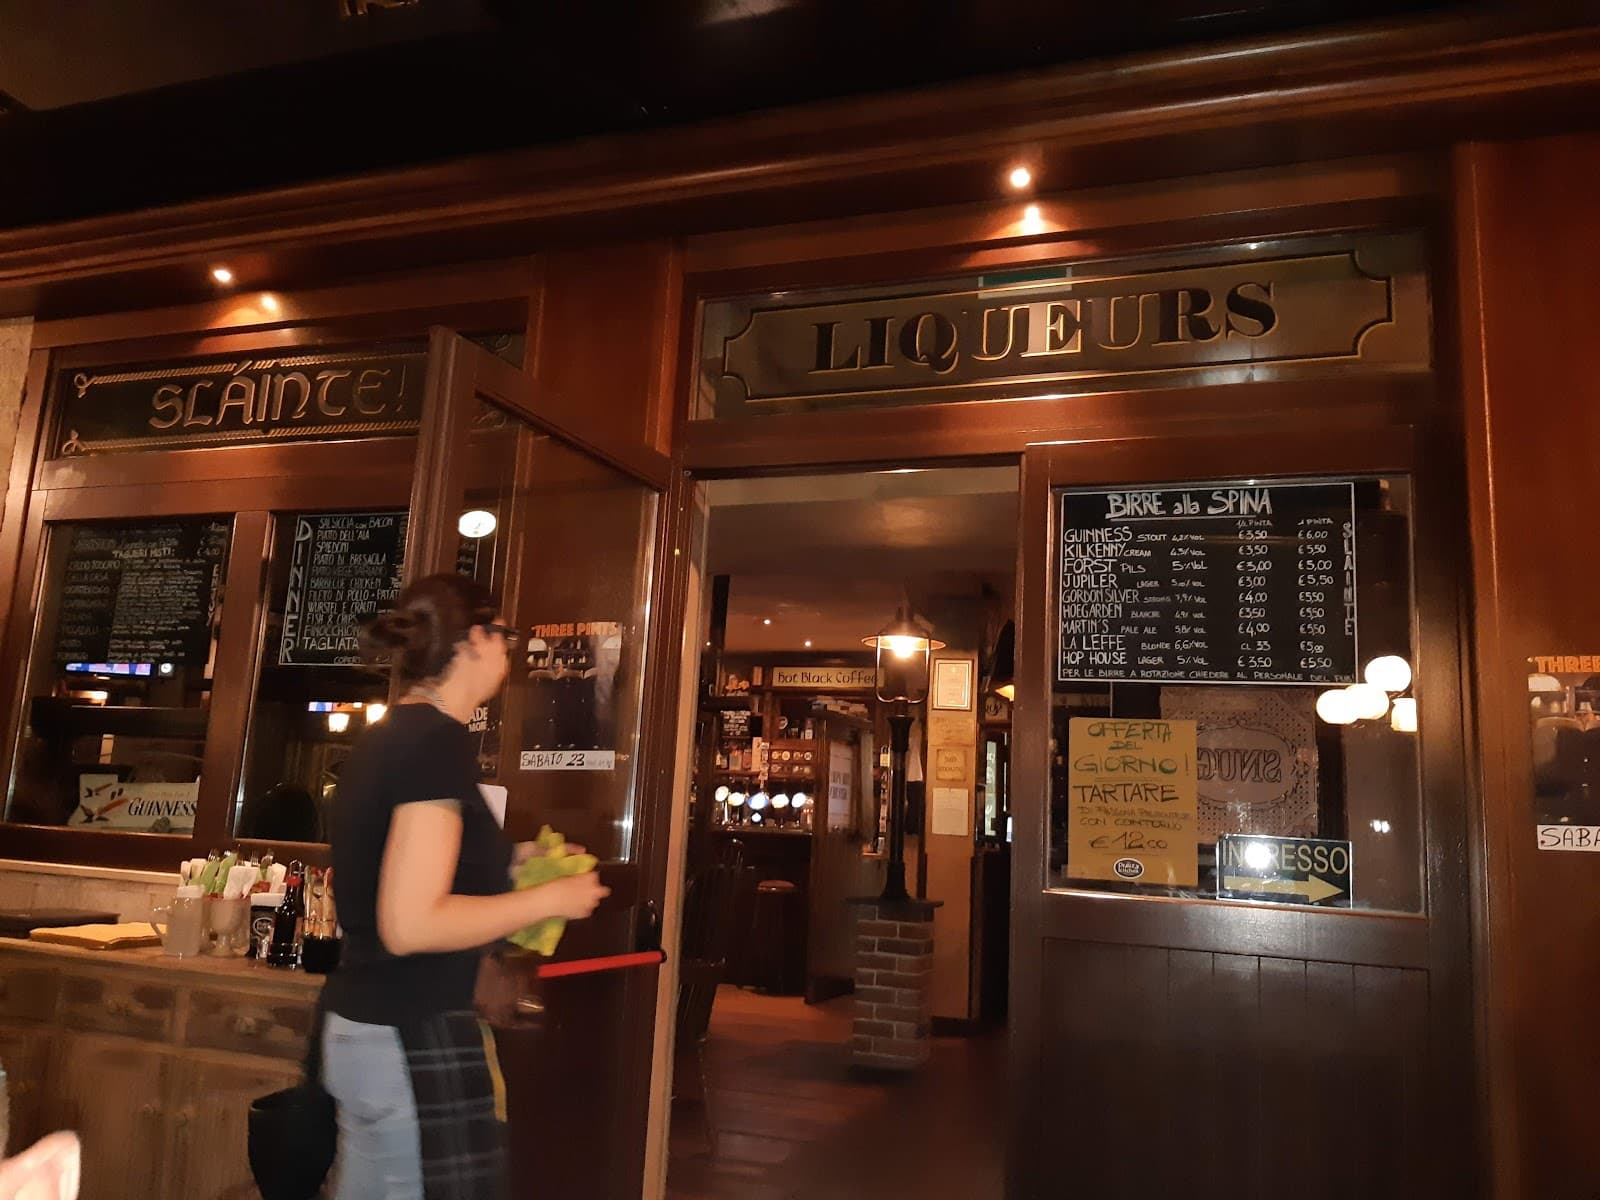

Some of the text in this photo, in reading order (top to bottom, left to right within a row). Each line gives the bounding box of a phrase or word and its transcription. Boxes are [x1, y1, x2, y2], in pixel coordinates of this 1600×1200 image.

[808, 280, 1278, 375] LIQUEURS
[1105, 488, 1273, 519] BIRRE alla SPINA
[1064, 526, 1133, 543] GUINNESS
[1136, 534, 1168, 542] STOUT
[1064, 542, 1127, 558] KILKENNY
[1123, 549, 1152, 557] CREAM
[1064, 559, 1118, 574] FORST
[1120, 563, 1146, 574] PILS
[1063, 573, 1118, 589] JUPILER
[1063, 603, 1122, 619] HOEGARDEN
[534, 623, 575, 639] THREE
[1062, 619, 1110, 634] MARTIN'S
[1120, 625, 1139, 634] PALE
[1143, 626, 1158, 634] ALE
[302, 637, 360, 650] TAGLIATA
[1062, 635, 1077, 650] LA
[1082, 634, 1127, 651] LEFFE
[1256, 640, 1271, 651] 33
[1062, 651, 1085, 665] HOP
[1089, 651, 1128, 665] HOUSE
[1137, 655, 1165, 665] LAGER
[1534, 655, 1600, 673] THREE
[801, 671, 833, 684] Black
[1062, 669, 1081, 678] PER
[1084, 669, 1094, 678] LE
[1129, 669, 1137, 678] A
[1141, 670, 1186, 679] ROTAZIONE
[1087, 721, 1171, 743] OFFERTA
[522, 752, 563, 768] SABATO
[566, 753, 585, 766] 23
[1072, 783, 1180, 804] TARTARE
[1222, 840, 1349, 875] INRESSO
